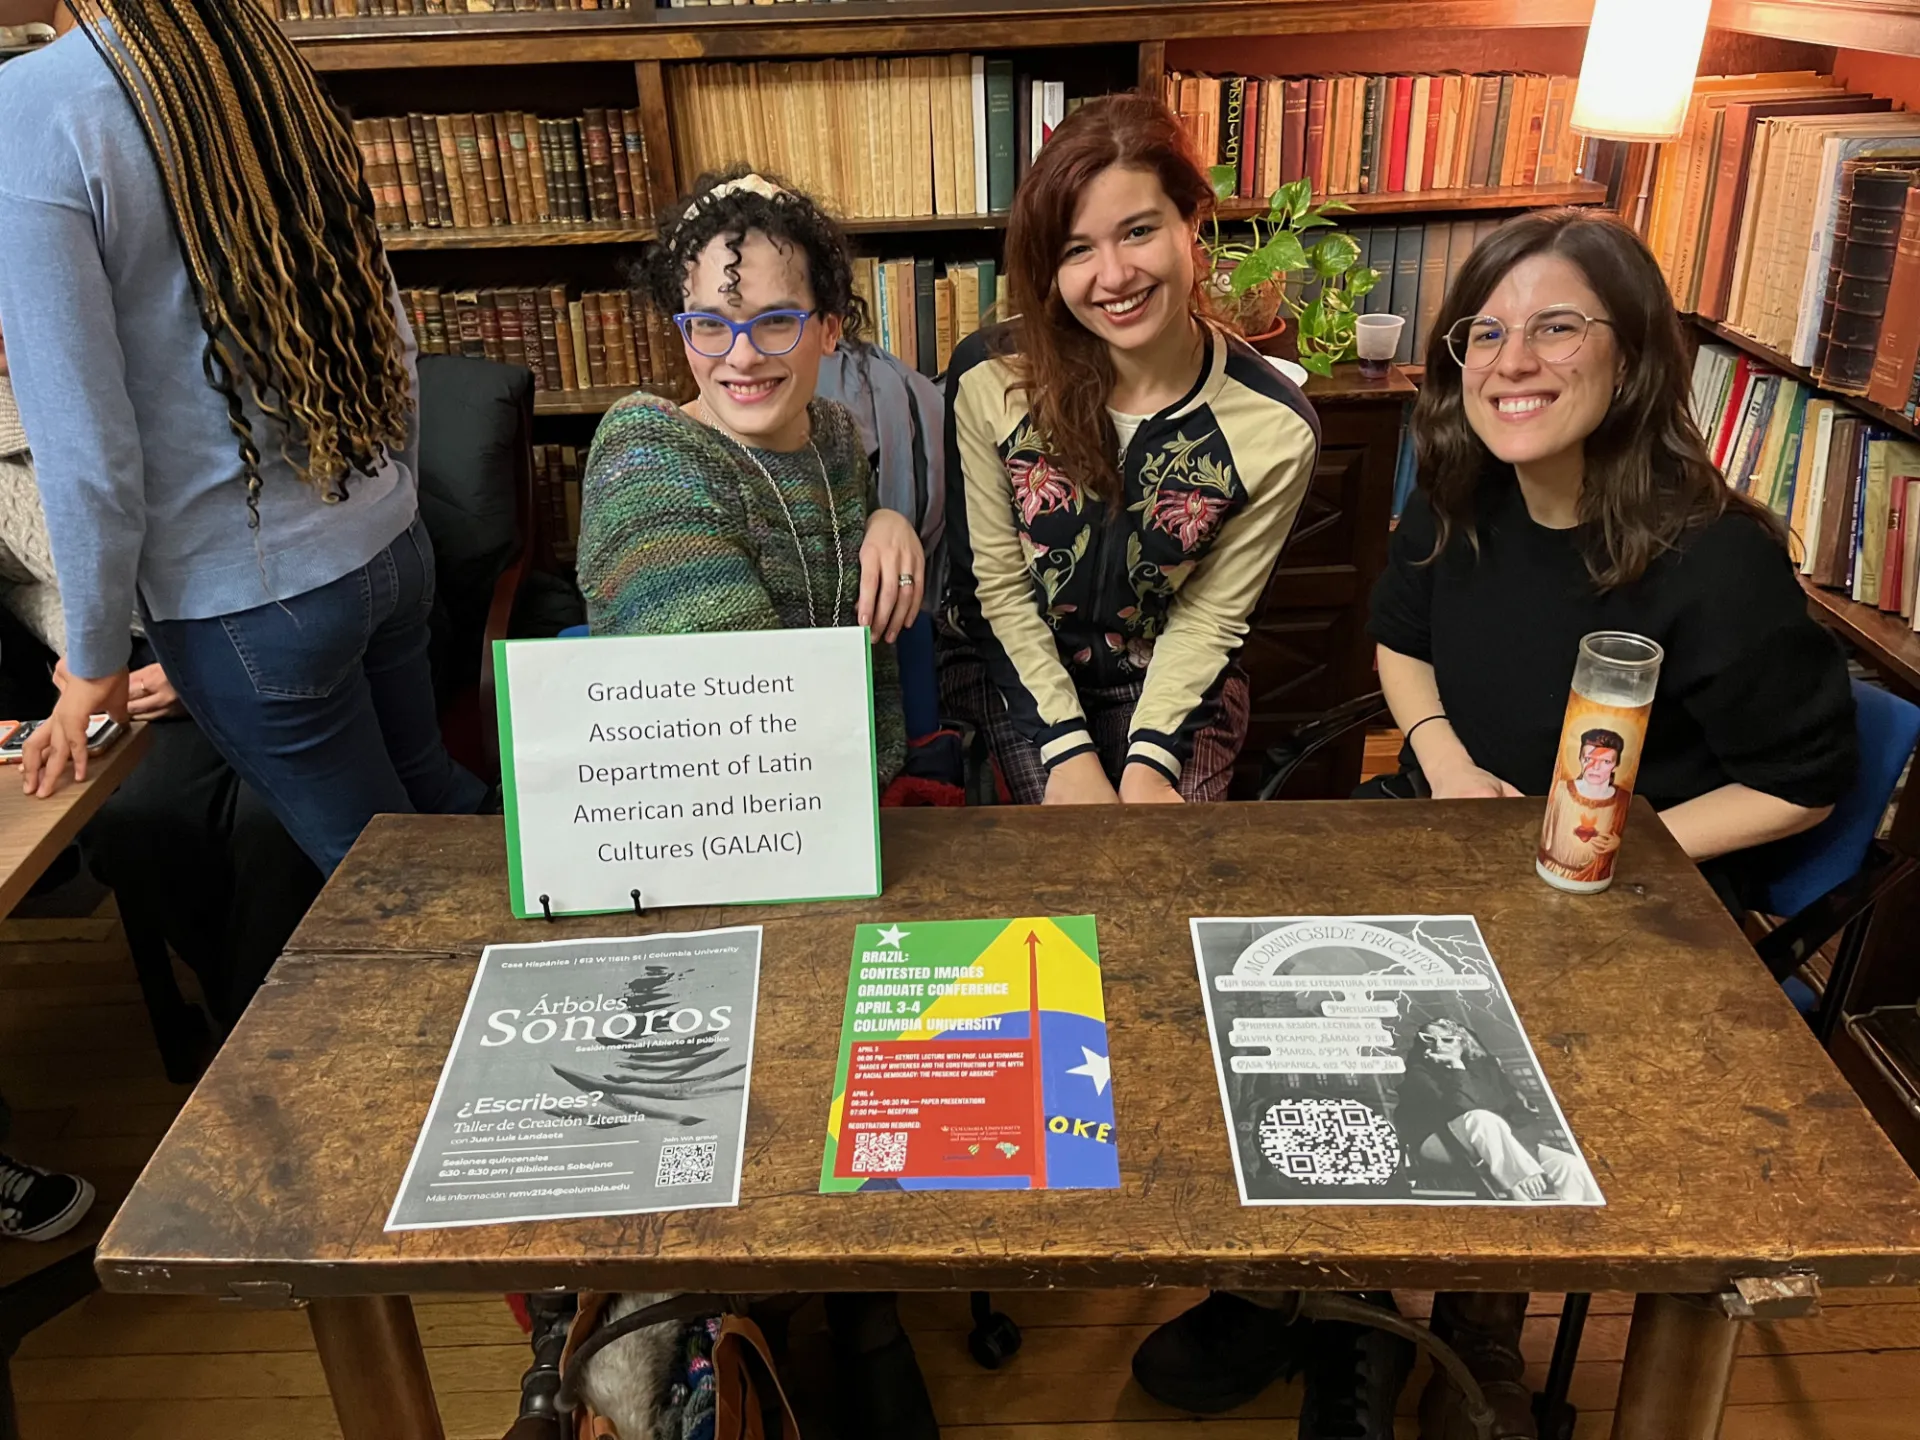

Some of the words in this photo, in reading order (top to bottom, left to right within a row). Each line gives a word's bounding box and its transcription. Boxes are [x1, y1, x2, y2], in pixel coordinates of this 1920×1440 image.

[588, 680, 695, 701] Graduate
[704, 674, 795, 697] Student
[589, 719, 721, 742] Association
[730, 714, 753, 736] of
[759, 714, 797, 734] the
[578, 758, 720, 786] Department
[728, 754, 751, 776] of
[759, 753, 812, 774] Latin
[573, 800, 684, 824] American
[692, 795, 734, 817] and
[743, 792, 822, 814] Iberian
[598, 840, 693, 862] Cultures
[702, 831, 803, 861] (GALAIC)
[525, 959, 570, 968] Hispánica
[649, 949, 691, 959] Columbia
[694, 946, 739, 957] University
[862, 951, 910, 963] BRAZIL:
[1243, 926, 1355, 977] MORNINGSIDE
[1360, 929, 1444, 975] FRIGHTS!
[860, 967, 930, 980] CONTESTED
[934, 966, 984, 979] IMAGES
[858, 984, 924, 997] GRADUATE
[927, 982, 1009, 996] CONFERENCE
[527, 993, 629, 1017] Árboles
[855, 1001, 892, 1014] APRIL
[896, 1001, 921, 1014] 3-4
[479, 1005, 733, 1047] Sonoros
[853, 1018, 922, 1032] COLUMBIA
[926, 1017, 1002, 1031] UNIVERSITY
[575, 1044, 605, 1052] Sesión
[606, 1041, 646, 1051] mensual
[651, 1038, 685, 1048] Abierto
[686, 1037, 695, 1046] al
[696, 1035, 730, 1046] público
[457, 1090, 604, 1119] ¿Escribes?
[453, 1121, 494, 1134] Taller
[496, 1118, 515, 1131] de
[518, 1115, 582, 1130] Creación
[586, 1111, 645, 1127] Literaria
[450, 1137, 468, 1145] con
[470, 1134, 494, 1144] Juan
[496, 1133, 516, 1142] Luis
[518, 1131, 563, 1141] Landaeta
[442, 1157, 487, 1167] Sesiones
[489, 1154, 549, 1166] quincenales
[490, 1168, 508, 1178] pm
[515, 1163, 565, 1174] Biblioteca
[567, 1160, 614, 1172] Sobejano
[425, 1194, 447, 1203] Más
